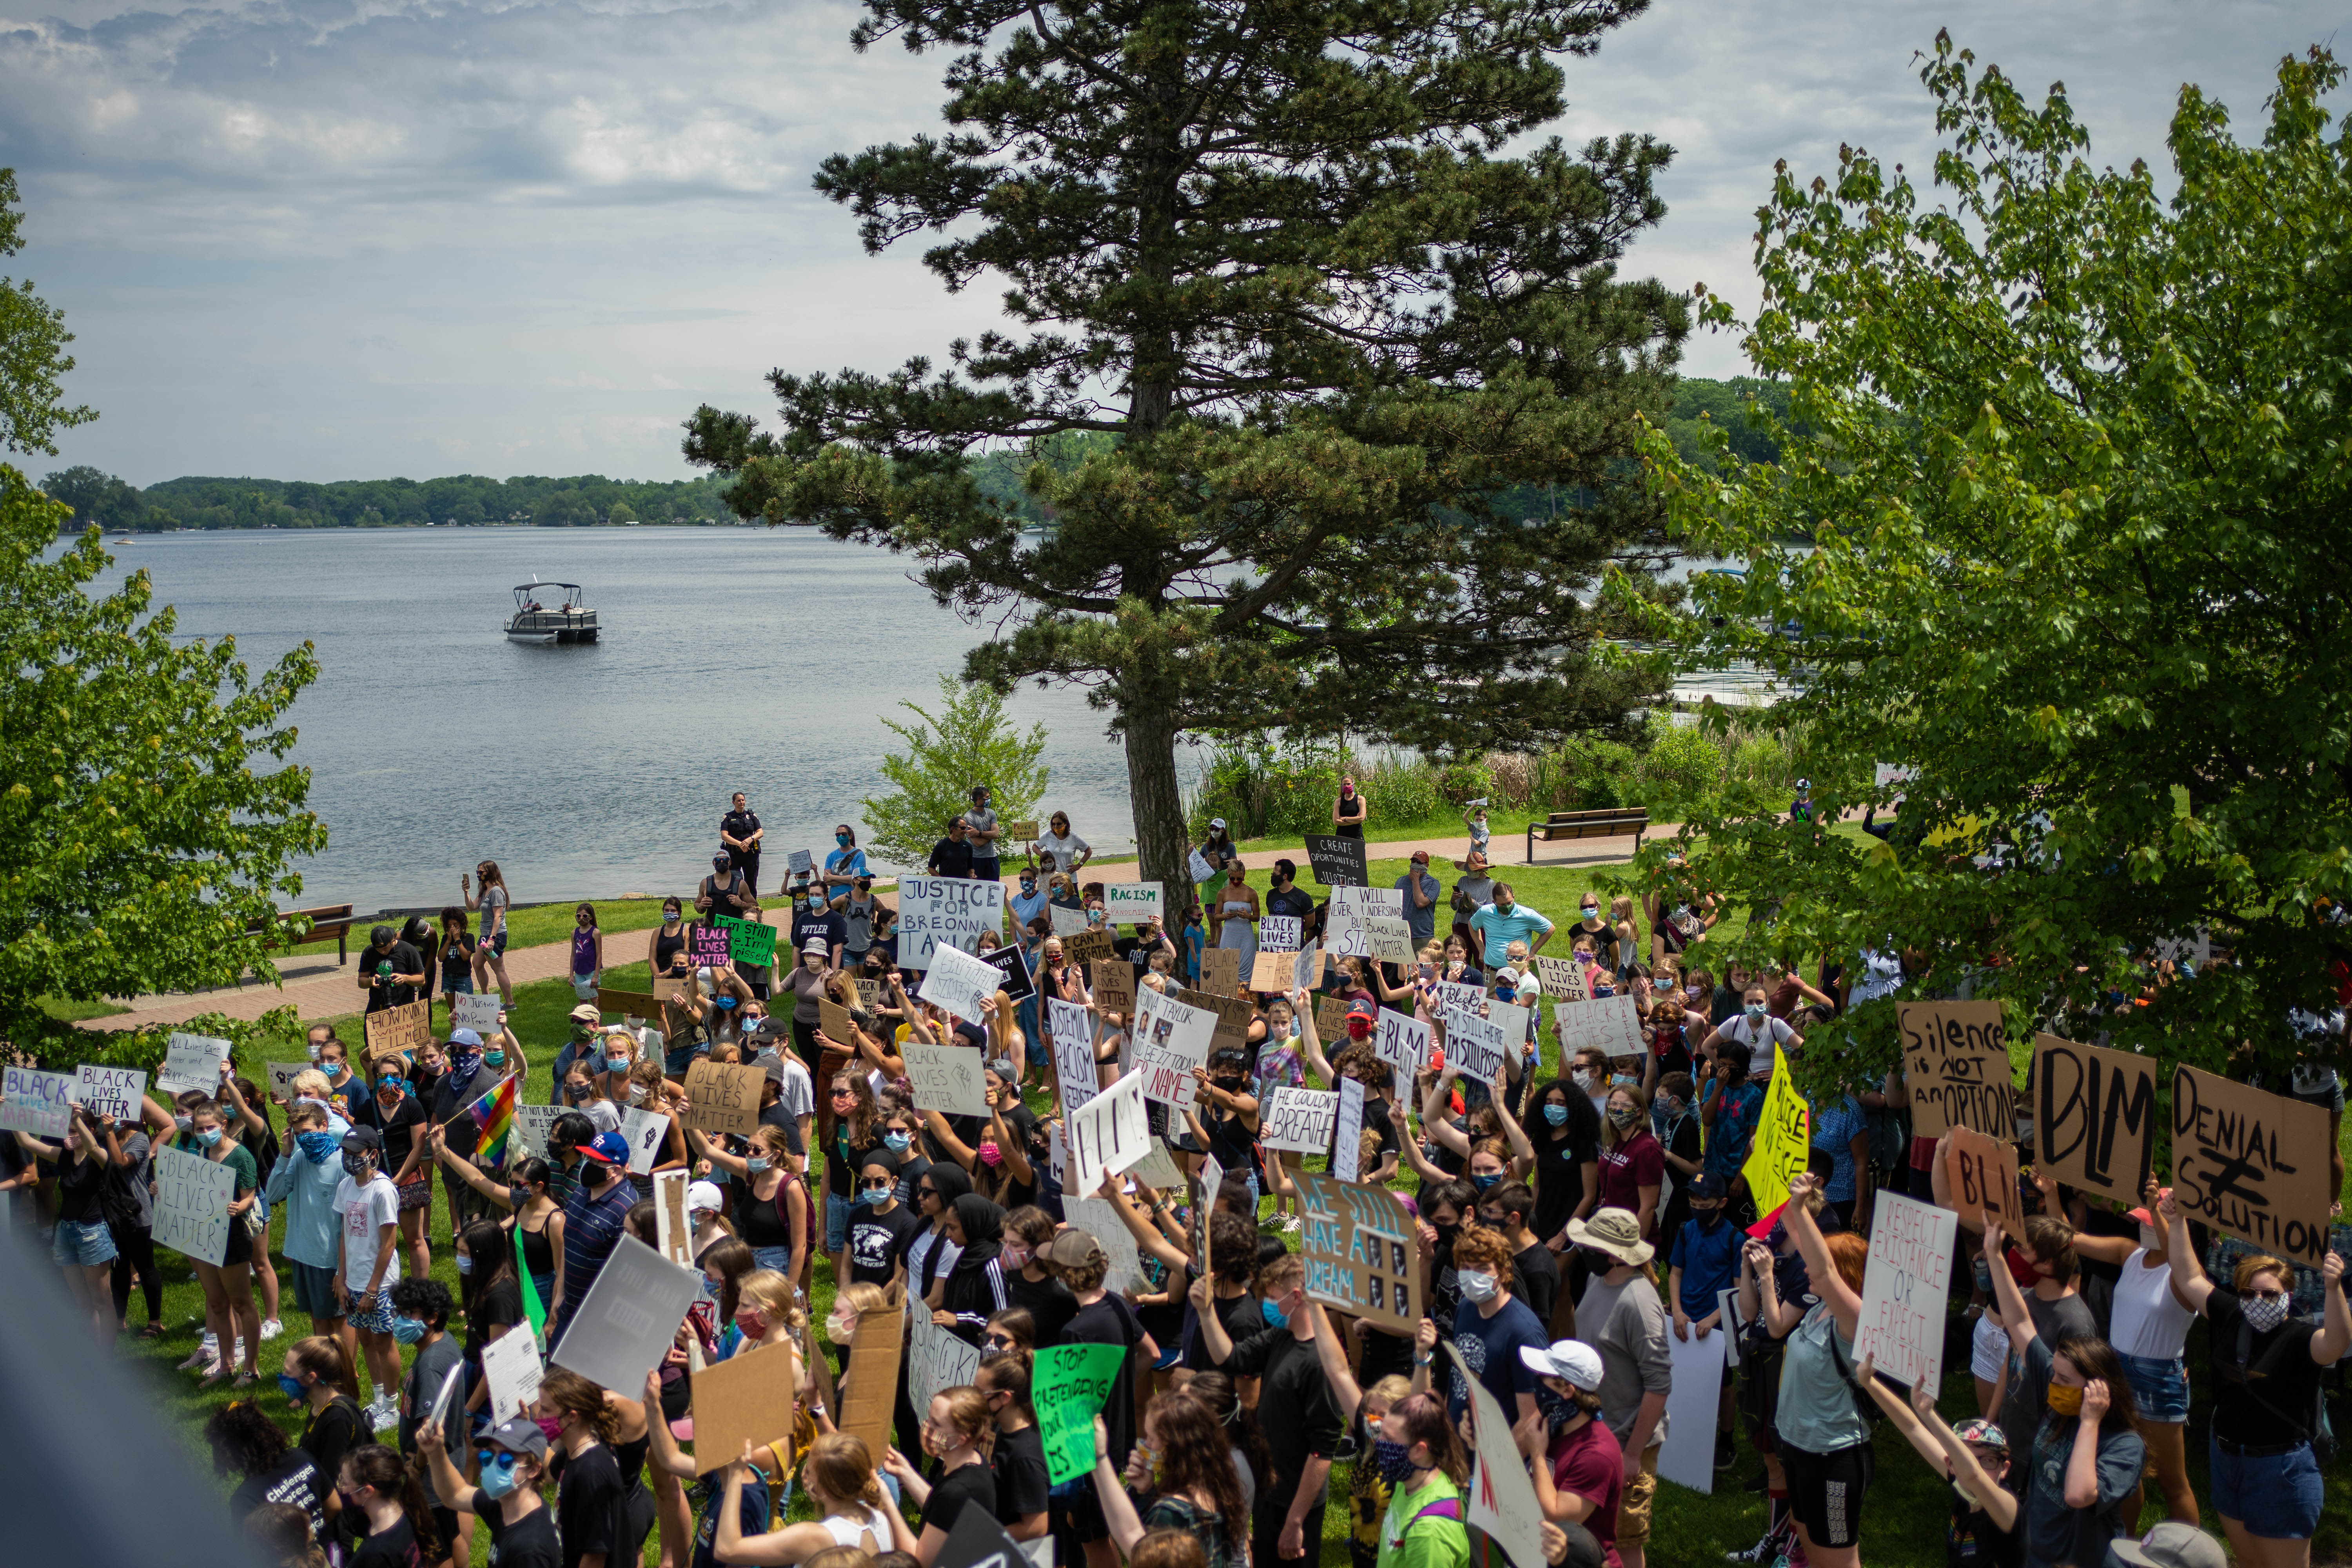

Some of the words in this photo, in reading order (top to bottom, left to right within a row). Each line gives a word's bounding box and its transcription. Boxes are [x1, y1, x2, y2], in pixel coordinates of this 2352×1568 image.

[1880, 772, 1907, 781] ANGRY
[1320, 840, 1352, 855] CREATE
[1321, 871, 1357, 887] JUSTICE
[905, 880, 1000, 907] JUSTICE
[1111, 888, 1156, 902] RACISM
[1337, 886, 1347, 904] I
[1359, 888, 1386, 903] WILL
[931, 900, 969, 916] FOR
[1111, 906, 1145, 916] PANDEMIC
[1330, 904, 1353, 916] NEVER
[1361, 905, 1403, 917] UNDERSTAND
[697, 927, 728, 940] BLACK
[745, 923, 769, 939] still
[801, 925, 828, 934] BUTLER
[904, 915, 991, 934] BREONNA
[1261, 917, 1294, 931] BLACK
[1366, 917, 1389, 935] BLACK
[1391, 924, 1409, 938] LIVES
[699, 941, 726, 952] LIVES
[745, 936, 764, 949] I'm
[1062, 938, 1070, 949] I
[1073, 932, 1102, 947] CAN'T
[1260, 931, 1293, 944] LIVES
[1374, 938, 1406, 957] MATTER
[690, 954, 729, 965] MATTER
[1073, 944, 1114, 964] BREATHE
[1205, 951, 1236, 967] BLACK
[1539, 957, 1577, 973] BLACK
[941, 953, 968, 975] SAY
[965, 962, 998, 993] THEIR
[1094, 964, 1127, 978] BLACK
[1098, 977, 1120, 987] LIVES
[1213, 969, 1236, 986] LIVES
[1549, 972, 1580, 985] LIVES
[456, 994, 466, 1006] NO
[931, 976, 970, 1003] NAMES
[1097, 987, 1130, 1006] MATTER
[1444, 985, 1480, 1007] Black
[1545, 983, 1586, 1000] MATTER
[373, 1011, 400, 1030] HOW
[403, 1000, 426, 1022] MANY
[1163, 1000, 1194, 1025] TAYLOR
[1196, 996, 1231, 1019] SAY
[1325, 1000, 1348, 1014] BLACK
[1563, 1002, 1615, 1028] BLACK
[457, 1013, 470, 1024] NO
[471, 1012, 487, 1025] Peace
[1050, 1000, 1089, 1043] SYSTEMIC
[1319, 1014, 1345, 1030] LIVES
[1462, 1014, 1481, 1038] STILL
[1484, 1024, 1503, 1045] HERE
[376, 1026, 428, 1051] FILMED
[454, 1030, 463, 1038] P
[1316, 1027, 1345, 1040] MATTER
[1564, 1025, 1613, 1051] LIVES
[1901, 1009, 2005, 1056] Silence
[169, 1037, 181, 1049] ALL
[185, 1039, 201, 1051] Lives
[905, 1047, 944, 1065] BLACK
[1055, 1040, 1095, 1085] RACISM
[1144, 1045, 1158, 1063] BE
[1157, 1050, 1171, 1066] 27
[1171, 1054, 1197, 1073] TODAY
[1461, 1038, 1482, 1075] STILL
[1914, 1056, 1929, 1074] is
[1940, 1055, 1986, 1078] NOT
[83, 1067, 135, 1089] BLACK
[163, 1068, 182, 1082] BLACK
[182, 1074, 198, 1084] LIVES
[695, 1065, 748, 1092] BLACK
[911, 1070, 949, 1086] LIVES
[1149, 1067, 1192, 1105] NAME.
[6, 1071, 70, 1105] BLACK
[92, 1086, 121, 1100] LIVES
[691, 1086, 742, 1109] LIVES
[19, 1095, 49, 1111] LIVES
[80, 1097, 129, 1118] MATTER
[914, 1090, 957, 1109] MATTER
[1277, 1090, 1293, 1105] HE
[1294, 1091, 1339, 1112] COULDN'T
[1944, 1082, 2019, 1139] OPTION
[3, 1107, 67, 1134] MATTER
[528, 1118, 537, 1127] BUT
[529, 1107, 540, 1116] NOT
[543, 1107, 561, 1116] BLACK
[621, 1105, 644, 1127] BLACK
[688, 1107, 745, 1129] MATTER
[2173, 1066, 2298, 1176] DENIAL
[1272, 1107, 1335, 1147] BREATHE
[2040, 1047, 2155, 1206] BLM
[165, 1151, 219, 1186] BLACK
[1695, 1174, 1703, 1184] E
[1959, 1149, 2021, 1228] BLM
[163, 1186, 215, 1214] LIVES
[1065, 1198, 1081, 1220] MY
[1289, 1171, 1338, 1216] WE
[1339, 1183, 1409, 1242] STILL
[2177, 1156, 2330, 1262] SOLUTION
[155, 1209, 219, 1250] MATTER
[869, 1225, 894, 1239] KENTWOOD
[1113, 1224, 1126, 1243] TO
[1886, 1200, 1942, 1247] RESPECT
[1301, 1218, 1343, 1256] HAVE
[1349, 1225, 1368, 1265] A
[1873, 1229, 1945, 1290] EXISTANCE
[1303, 1258, 1367, 1306] DREAM...
[1893, 1269, 1915, 1306] OR
[1879, 1301, 1926, 1350] EXPECT
[915, 1298, 973, 1387] BLACK
[1054, 1348, 1087, 1377] STOP
[1861, 1325, 1936, 1388] RESISTANCE
[1034, 1377, 1108, 1414] PRETENDING
[1041, 1412, 1063, 1443] YOUR
[1047, 1445, 1070, 1477] IS
[267, 1465, 315, 1503] Challenges
